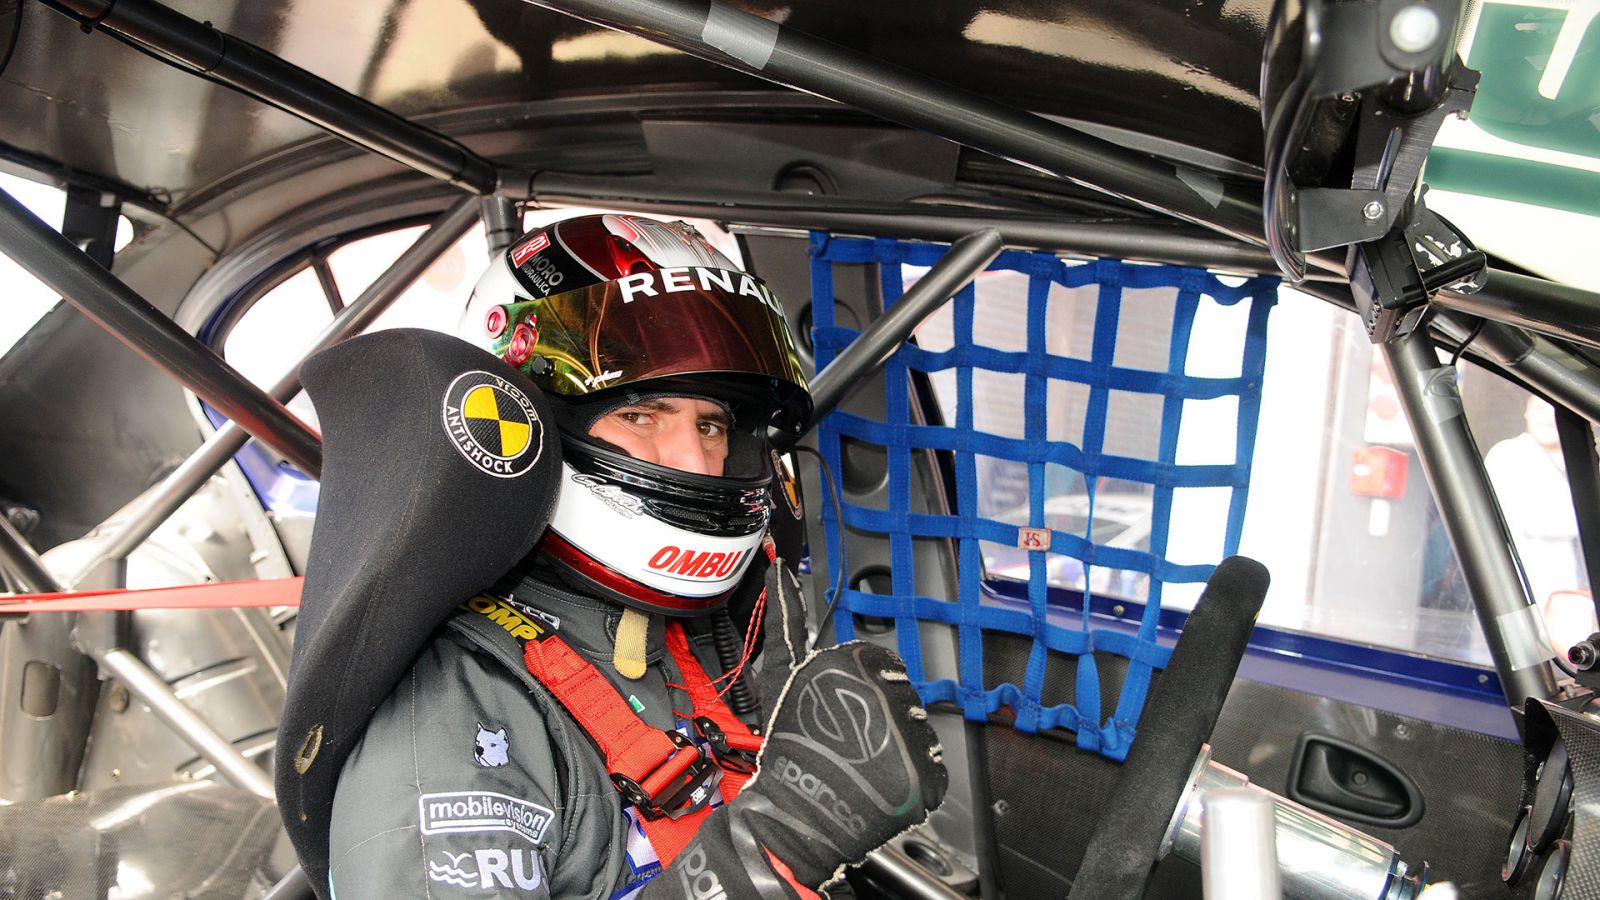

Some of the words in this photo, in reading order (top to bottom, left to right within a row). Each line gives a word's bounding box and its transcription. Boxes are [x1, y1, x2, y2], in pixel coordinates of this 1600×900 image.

[528, 253, 564, 287] MORO
[617, 266, 784, 317] RENAU
[446, 405, 514, 474] ANTISHOCK
[648, 545, 742, 578] OMBU
[467, 596, 538, 641] OMP
[429, 796, 546, 831] mobilevision
[769, 755, 867, 840] sparco
[474, 848, 549, 894] RU
